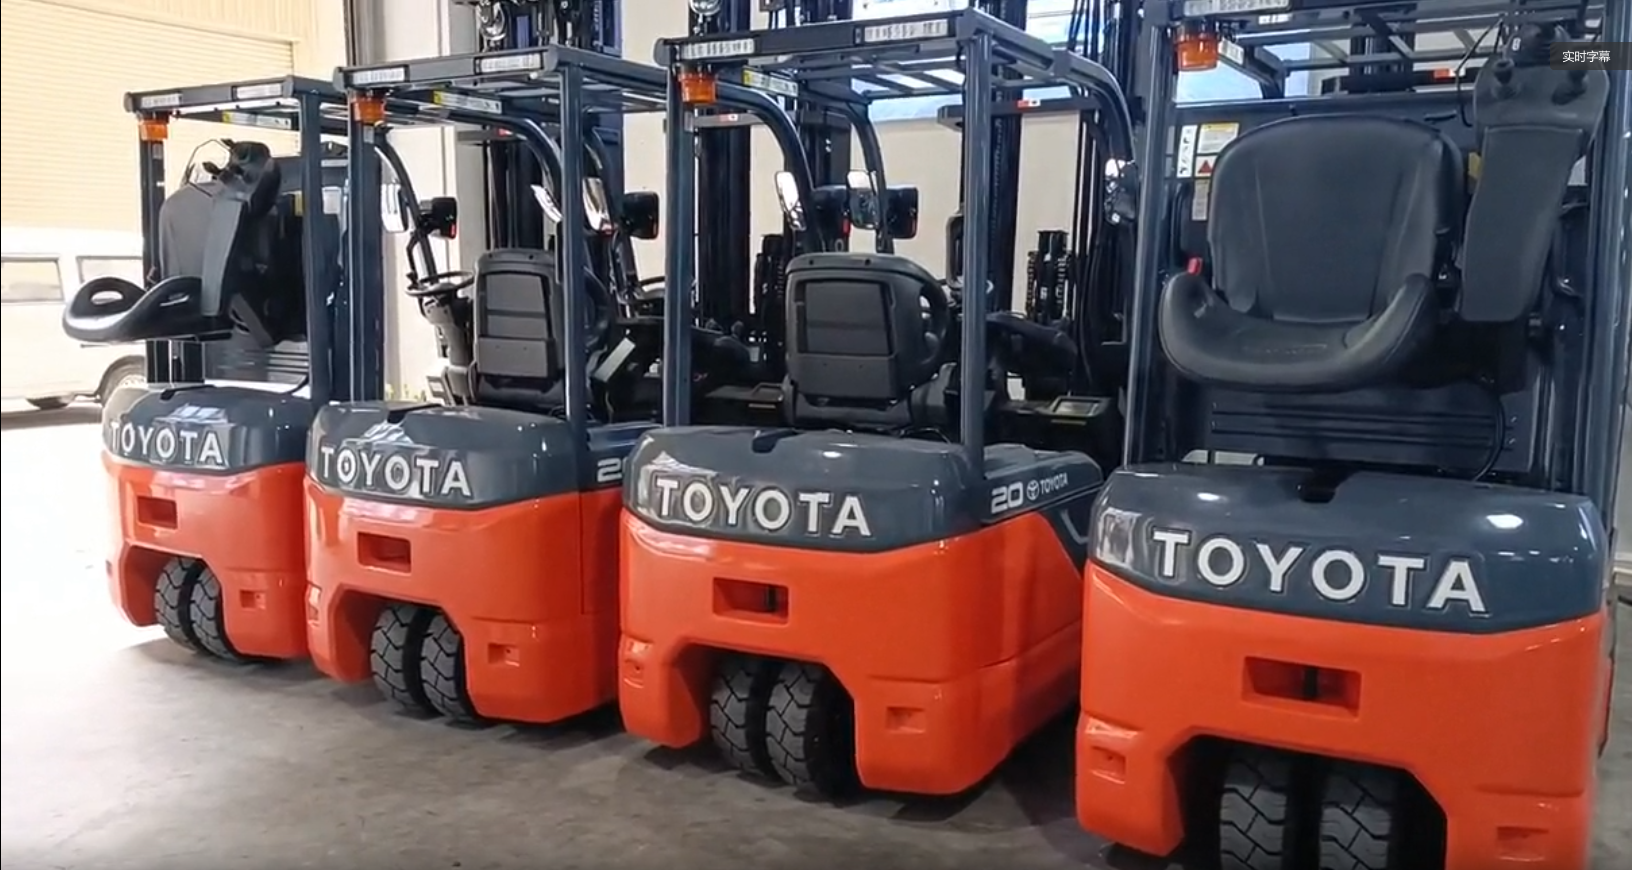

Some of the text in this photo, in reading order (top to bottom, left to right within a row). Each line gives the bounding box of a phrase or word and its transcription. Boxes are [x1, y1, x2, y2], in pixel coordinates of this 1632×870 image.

[109, 421, 225, 465] TOYOTA
[320, 448, 472, 497] TOYOTA
[597, 457, 627, 482] 2
[656, 477, 872, 537] TOYOTA
[991, 472, 1069, 514] 20 TOYOTA
[1153, 530, 1486, 612] TOYOTA
